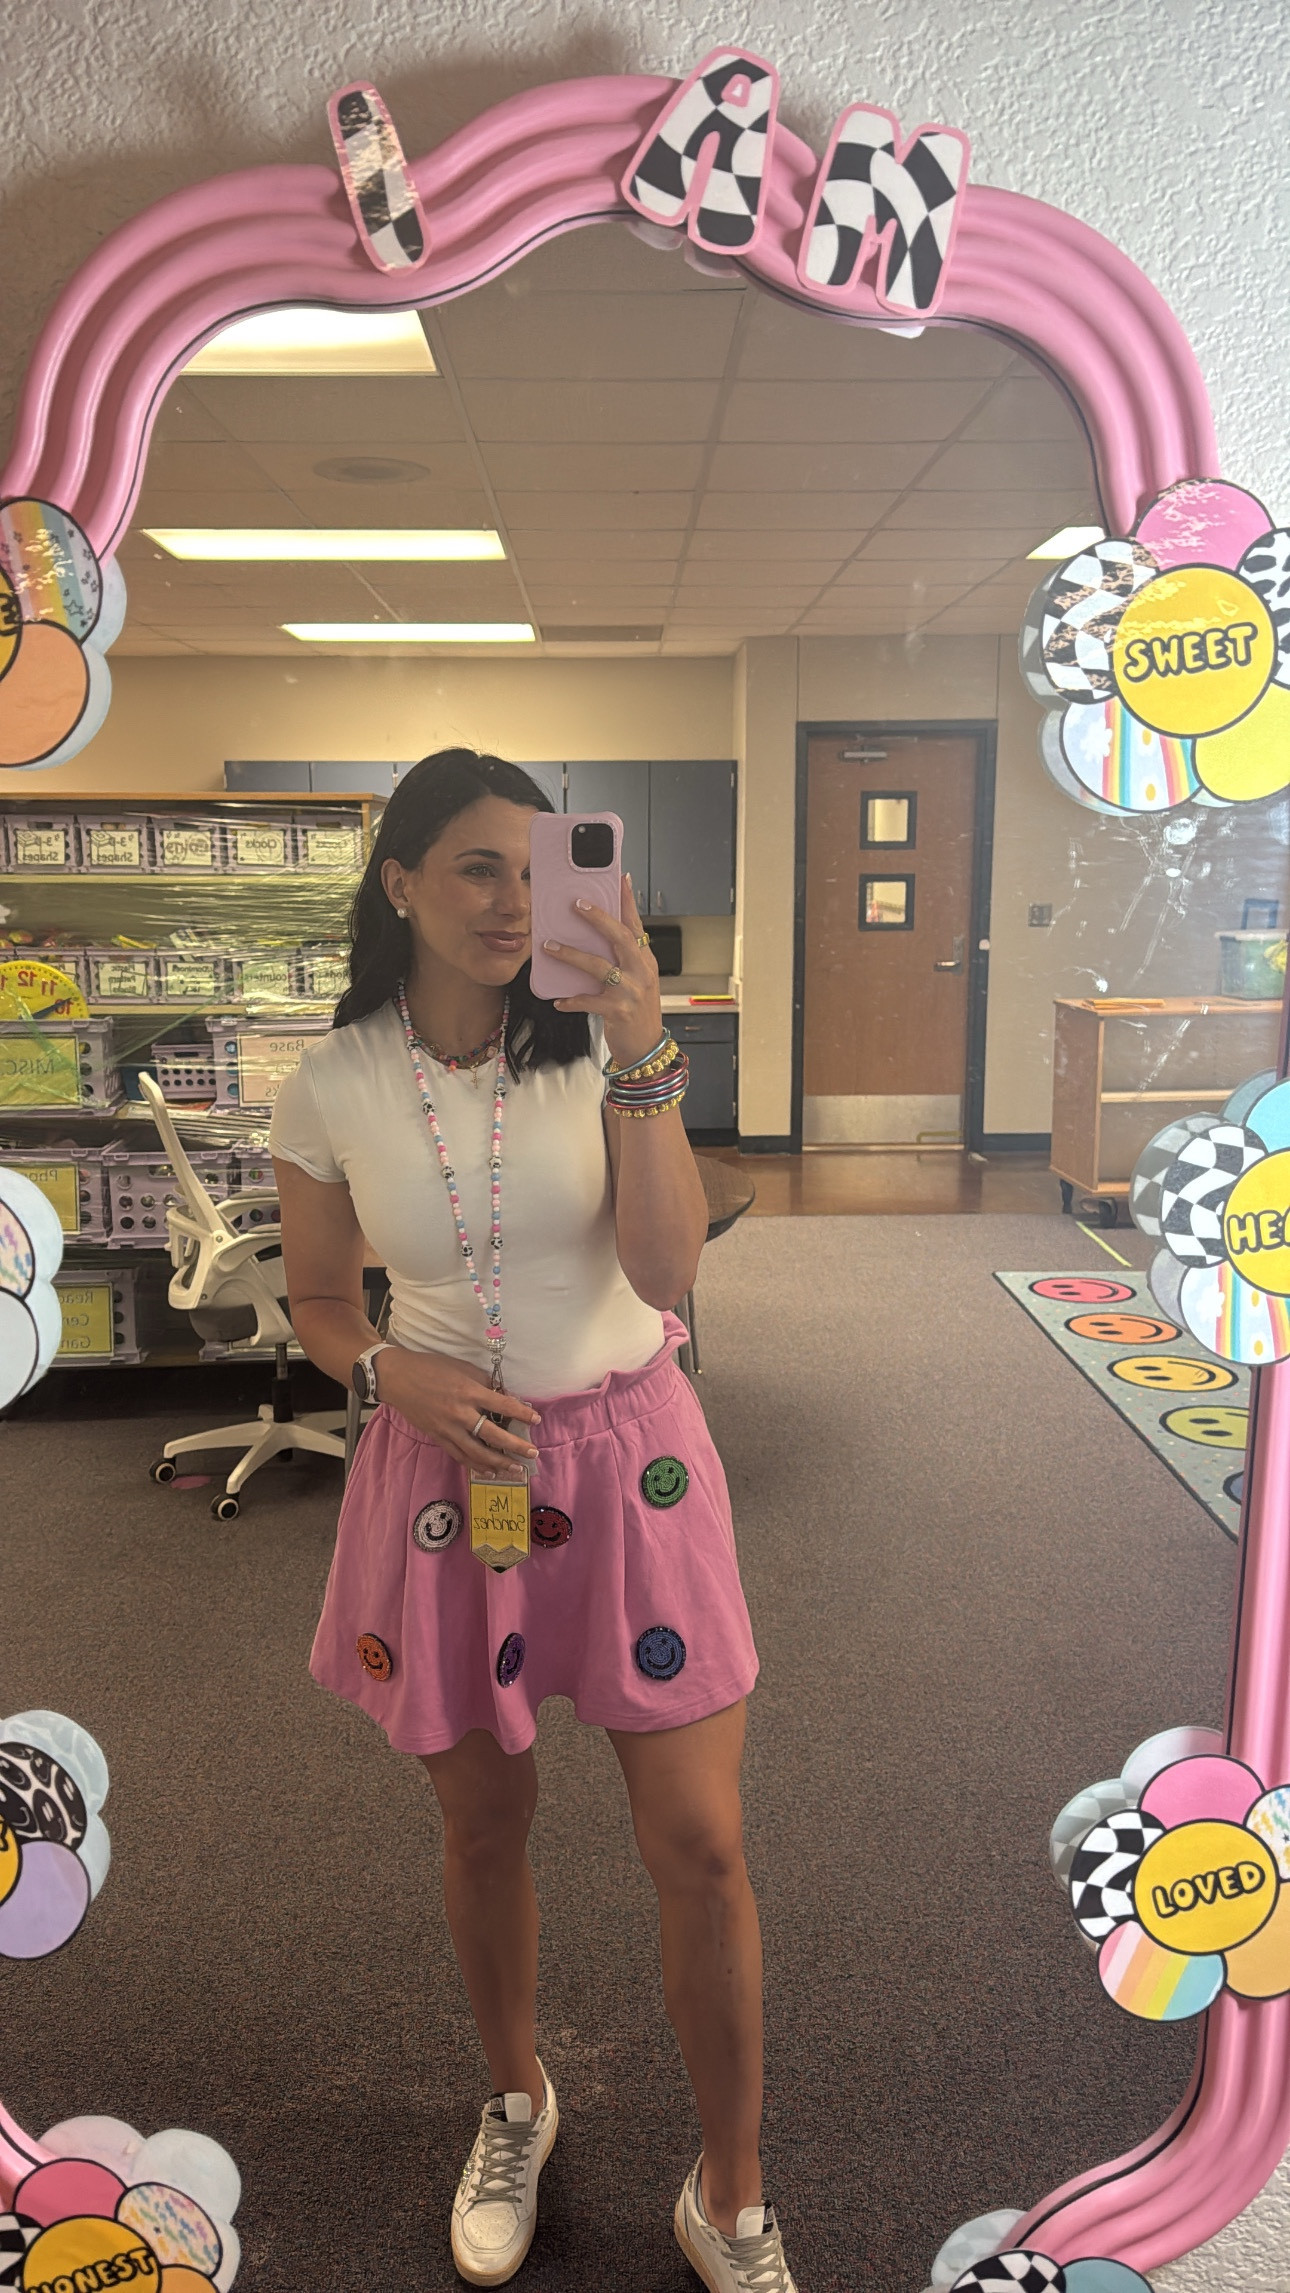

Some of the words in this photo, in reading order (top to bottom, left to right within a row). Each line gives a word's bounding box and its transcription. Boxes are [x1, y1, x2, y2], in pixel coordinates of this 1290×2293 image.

[327, 80, 431, 276] I
[621, 45, 971, 318] AM
[1123, 622, 1258, 683] SWEET
[1152, 1861, 1265, 1918] LOVED
